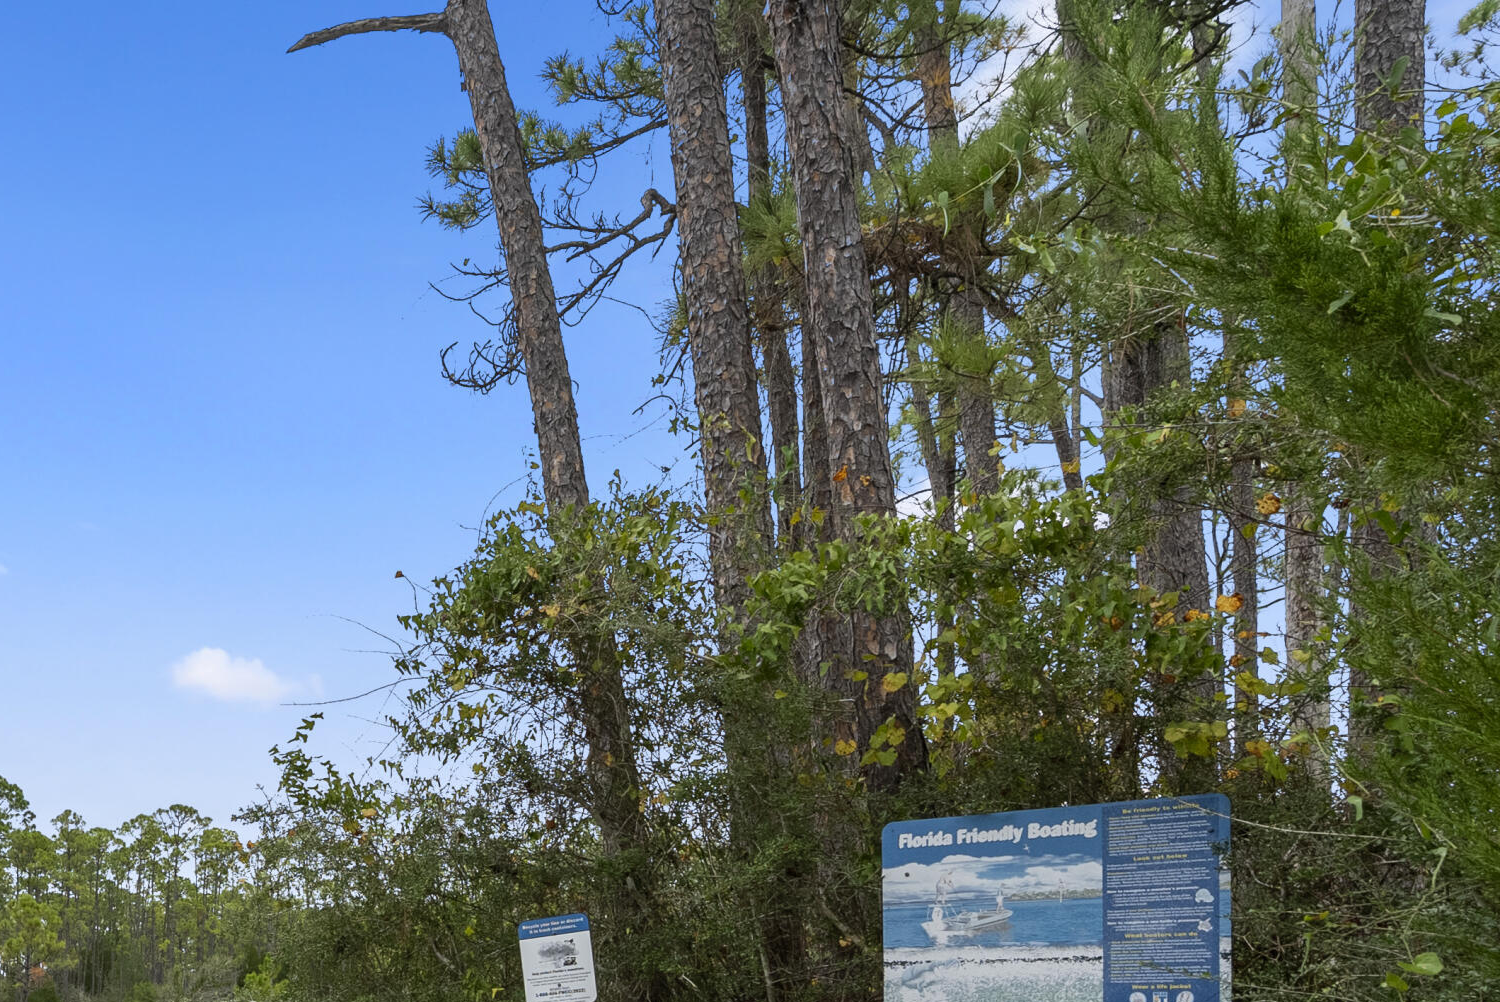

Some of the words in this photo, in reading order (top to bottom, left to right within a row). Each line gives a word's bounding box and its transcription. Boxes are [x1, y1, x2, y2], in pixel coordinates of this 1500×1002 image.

[899, 831, 952, 849] Florida
[957, 825, 1023, 844] Friendly
[1027, 818, 1098, 839] Boating
